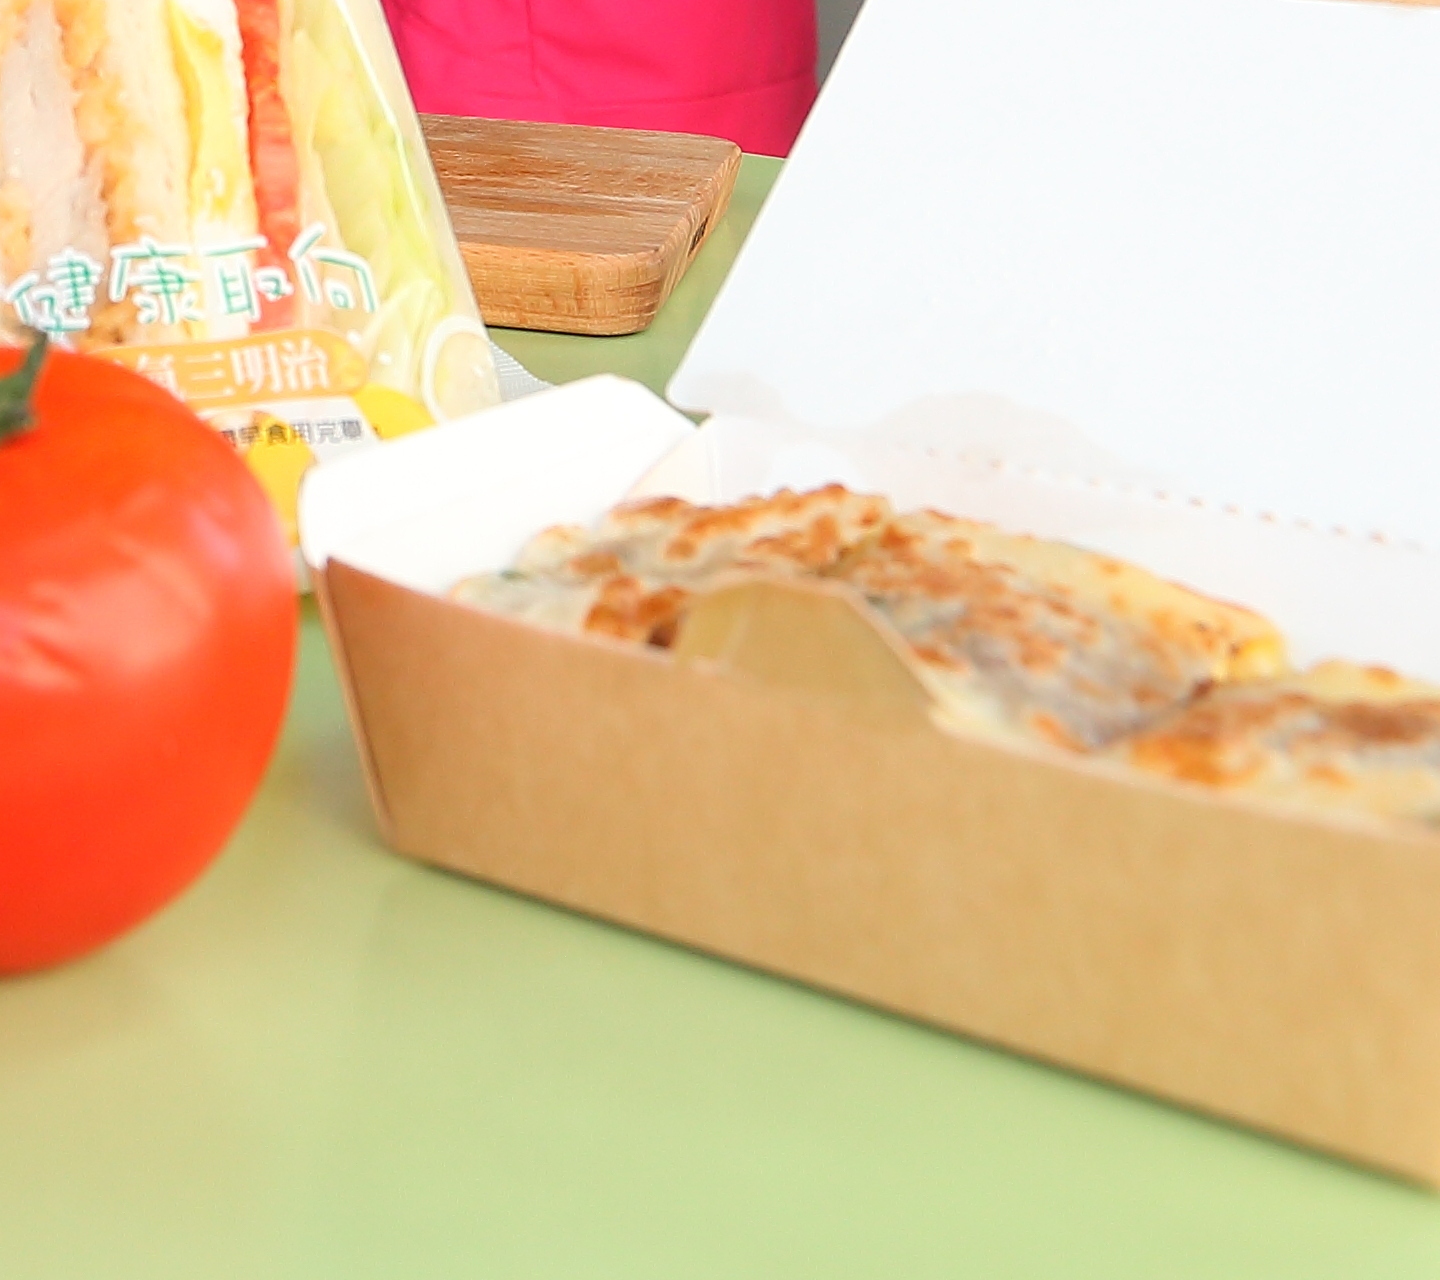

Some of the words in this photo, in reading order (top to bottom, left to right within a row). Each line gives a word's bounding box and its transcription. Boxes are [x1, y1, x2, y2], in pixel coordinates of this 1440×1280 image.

[6, 220, 379, 338] 健康取向
[114, 336, 331, 400] 氣三明治
